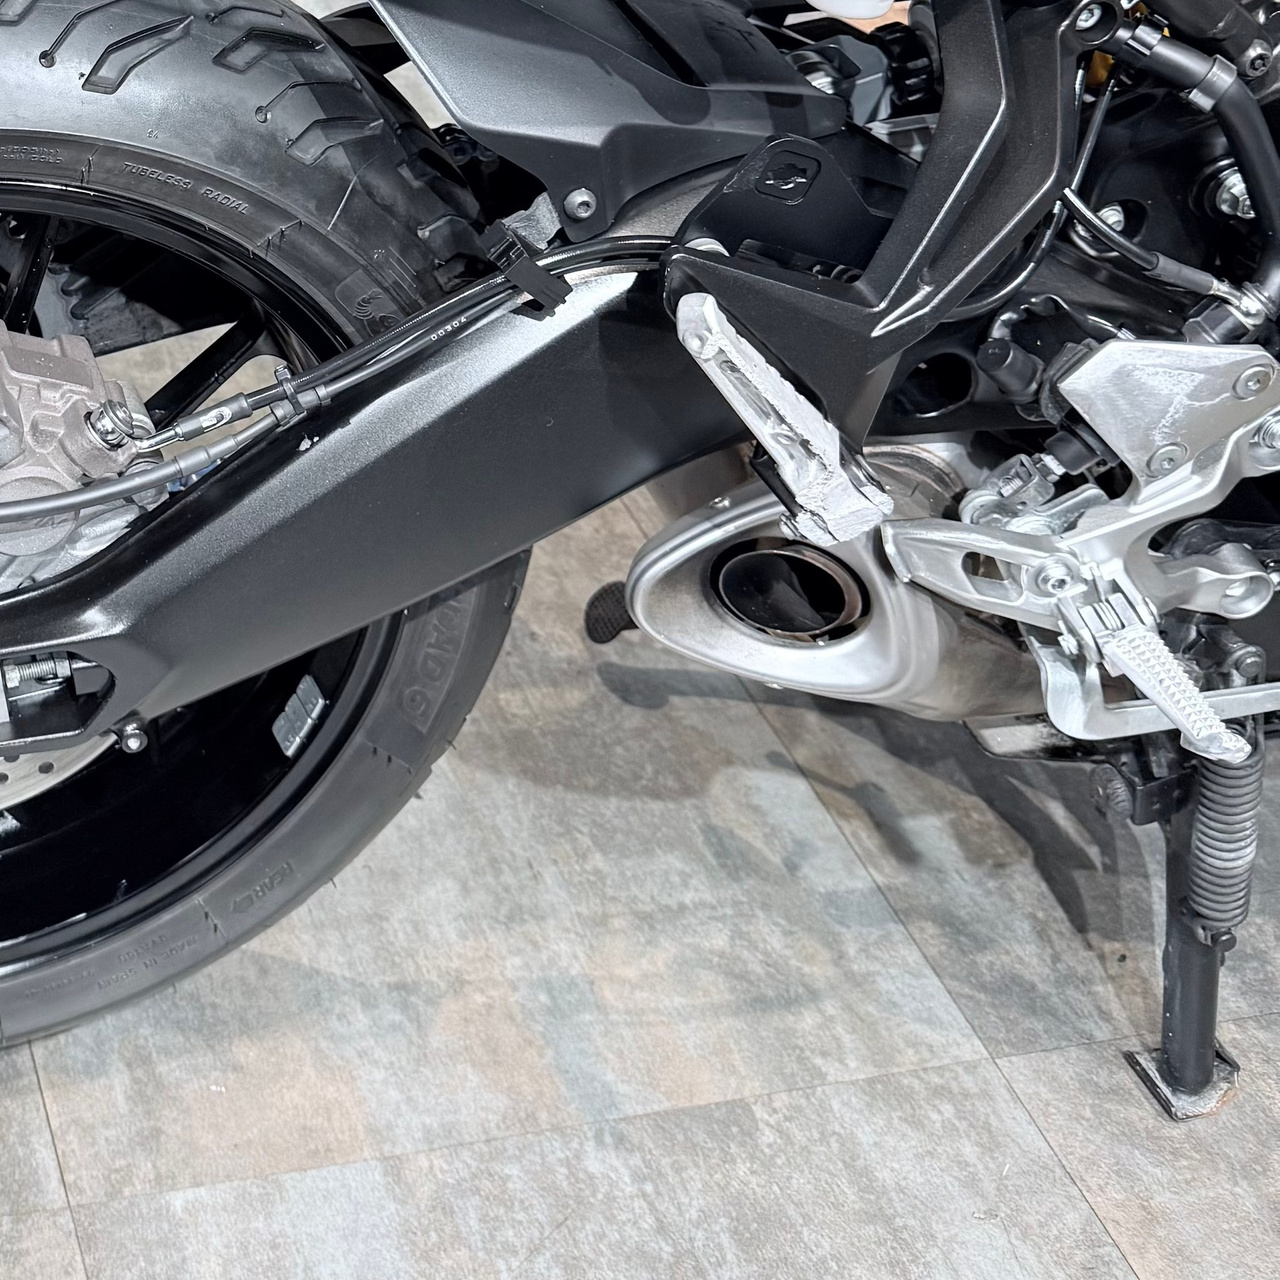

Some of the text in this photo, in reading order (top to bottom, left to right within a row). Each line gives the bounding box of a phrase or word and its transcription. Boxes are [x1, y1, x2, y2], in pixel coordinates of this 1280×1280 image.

[122, 161, 249, 215] TUBELESS RADIAL
[430, 315, 468, 342] 00304
